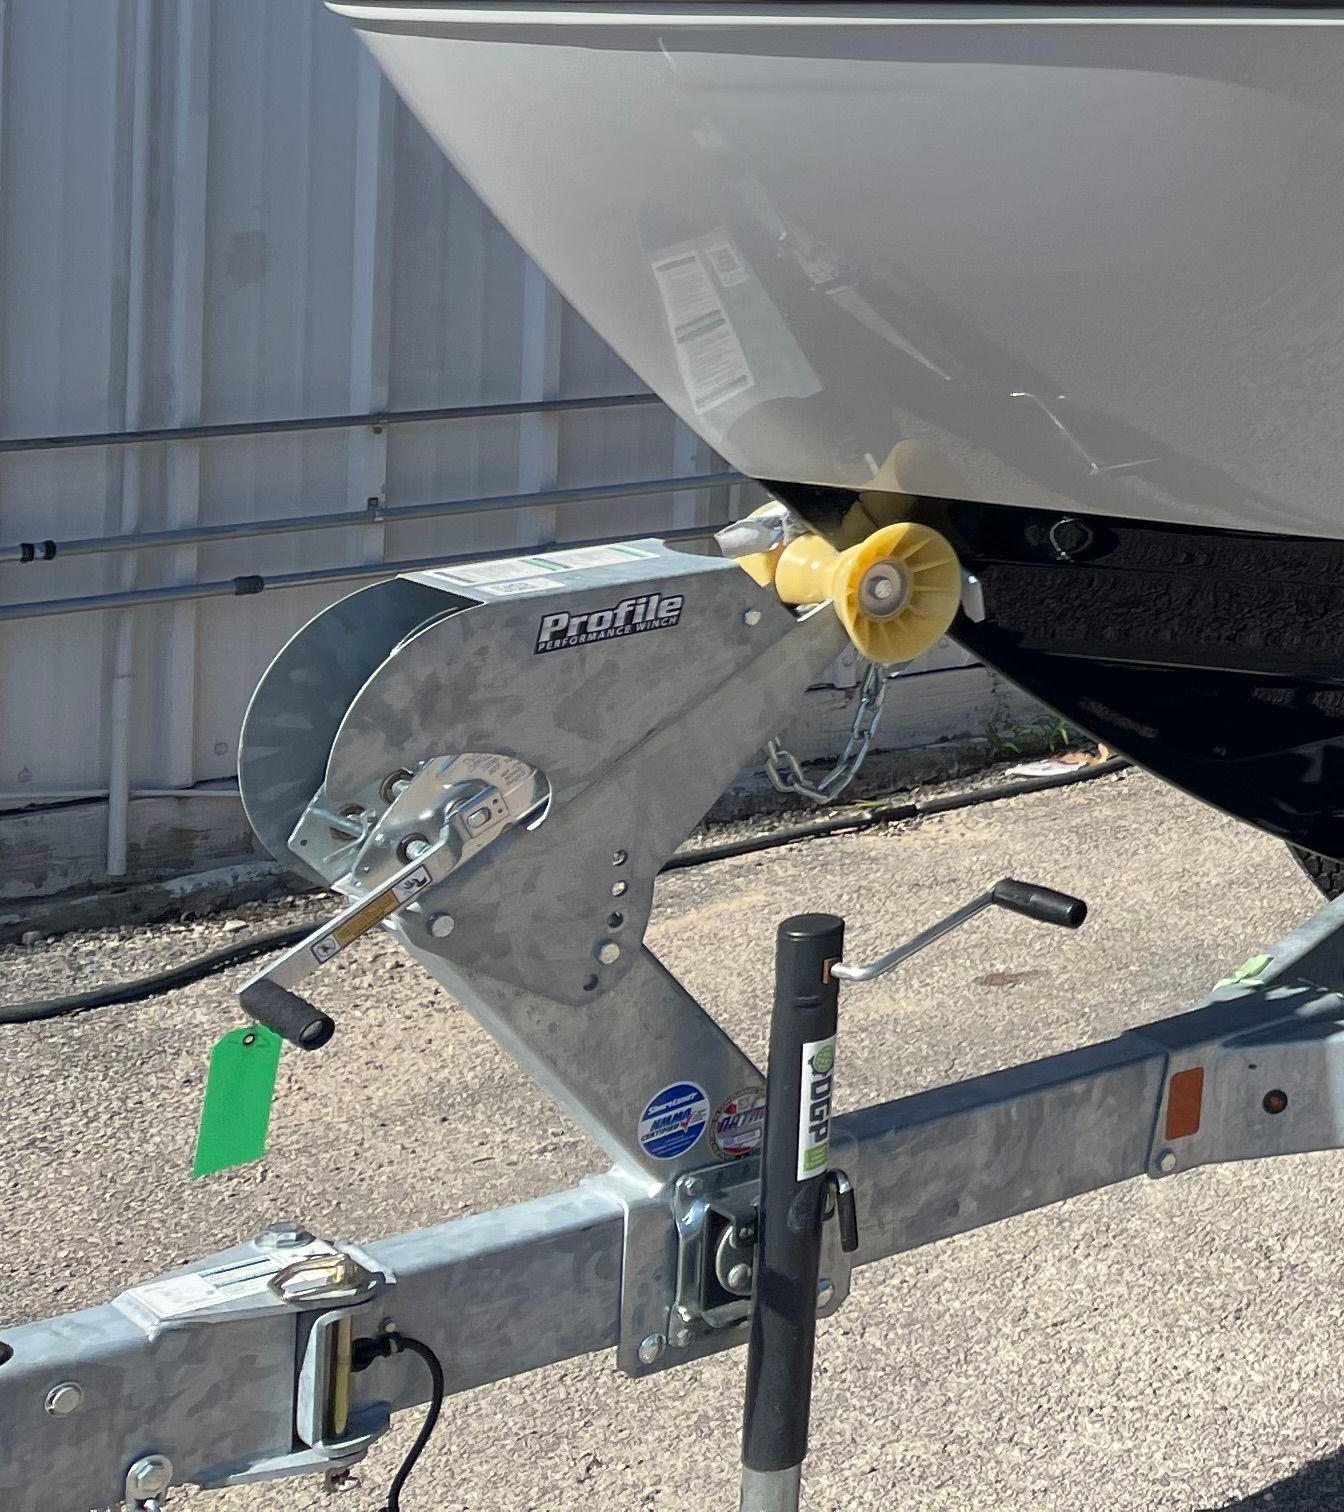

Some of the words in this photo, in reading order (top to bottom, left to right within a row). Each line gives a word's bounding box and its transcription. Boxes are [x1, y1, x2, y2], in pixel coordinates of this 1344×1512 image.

[537, 624, 632, 653] PERFORMANCE
[635, 616, 678, 632] WINCH
[538, 593, 684, 643] Profile
